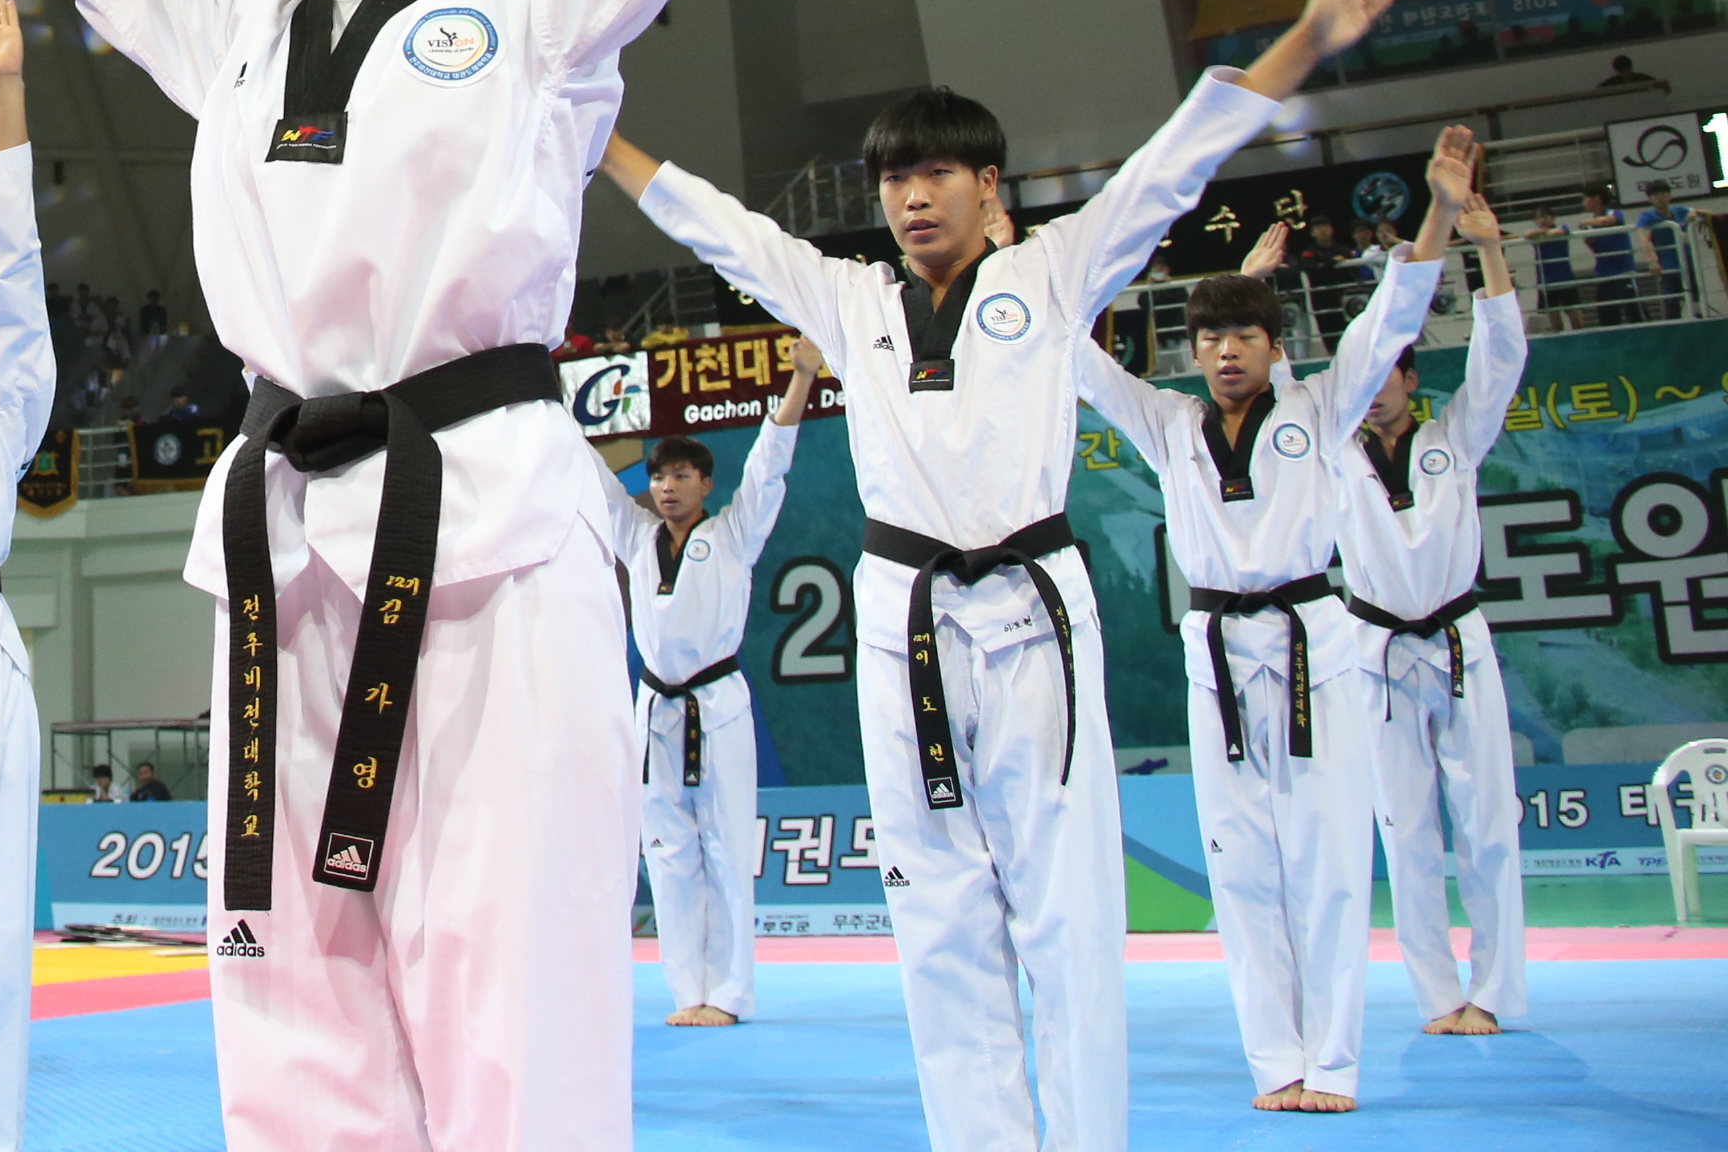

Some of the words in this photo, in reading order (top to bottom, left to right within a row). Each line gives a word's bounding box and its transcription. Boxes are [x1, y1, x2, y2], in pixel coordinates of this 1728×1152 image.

[684, 399, 761, 425] Gachon
[385, 574, 421, 597] 12기
[241, 594, 264, 838] 전주비전대학교
[1517, 790, 1590, 829] 15
[756, 816, 880, 884] 권도
[1585, 850, 1622, 869] KTA
[327, 857, 368, 873] adidas
[216, 942, 266, 958] adidas
